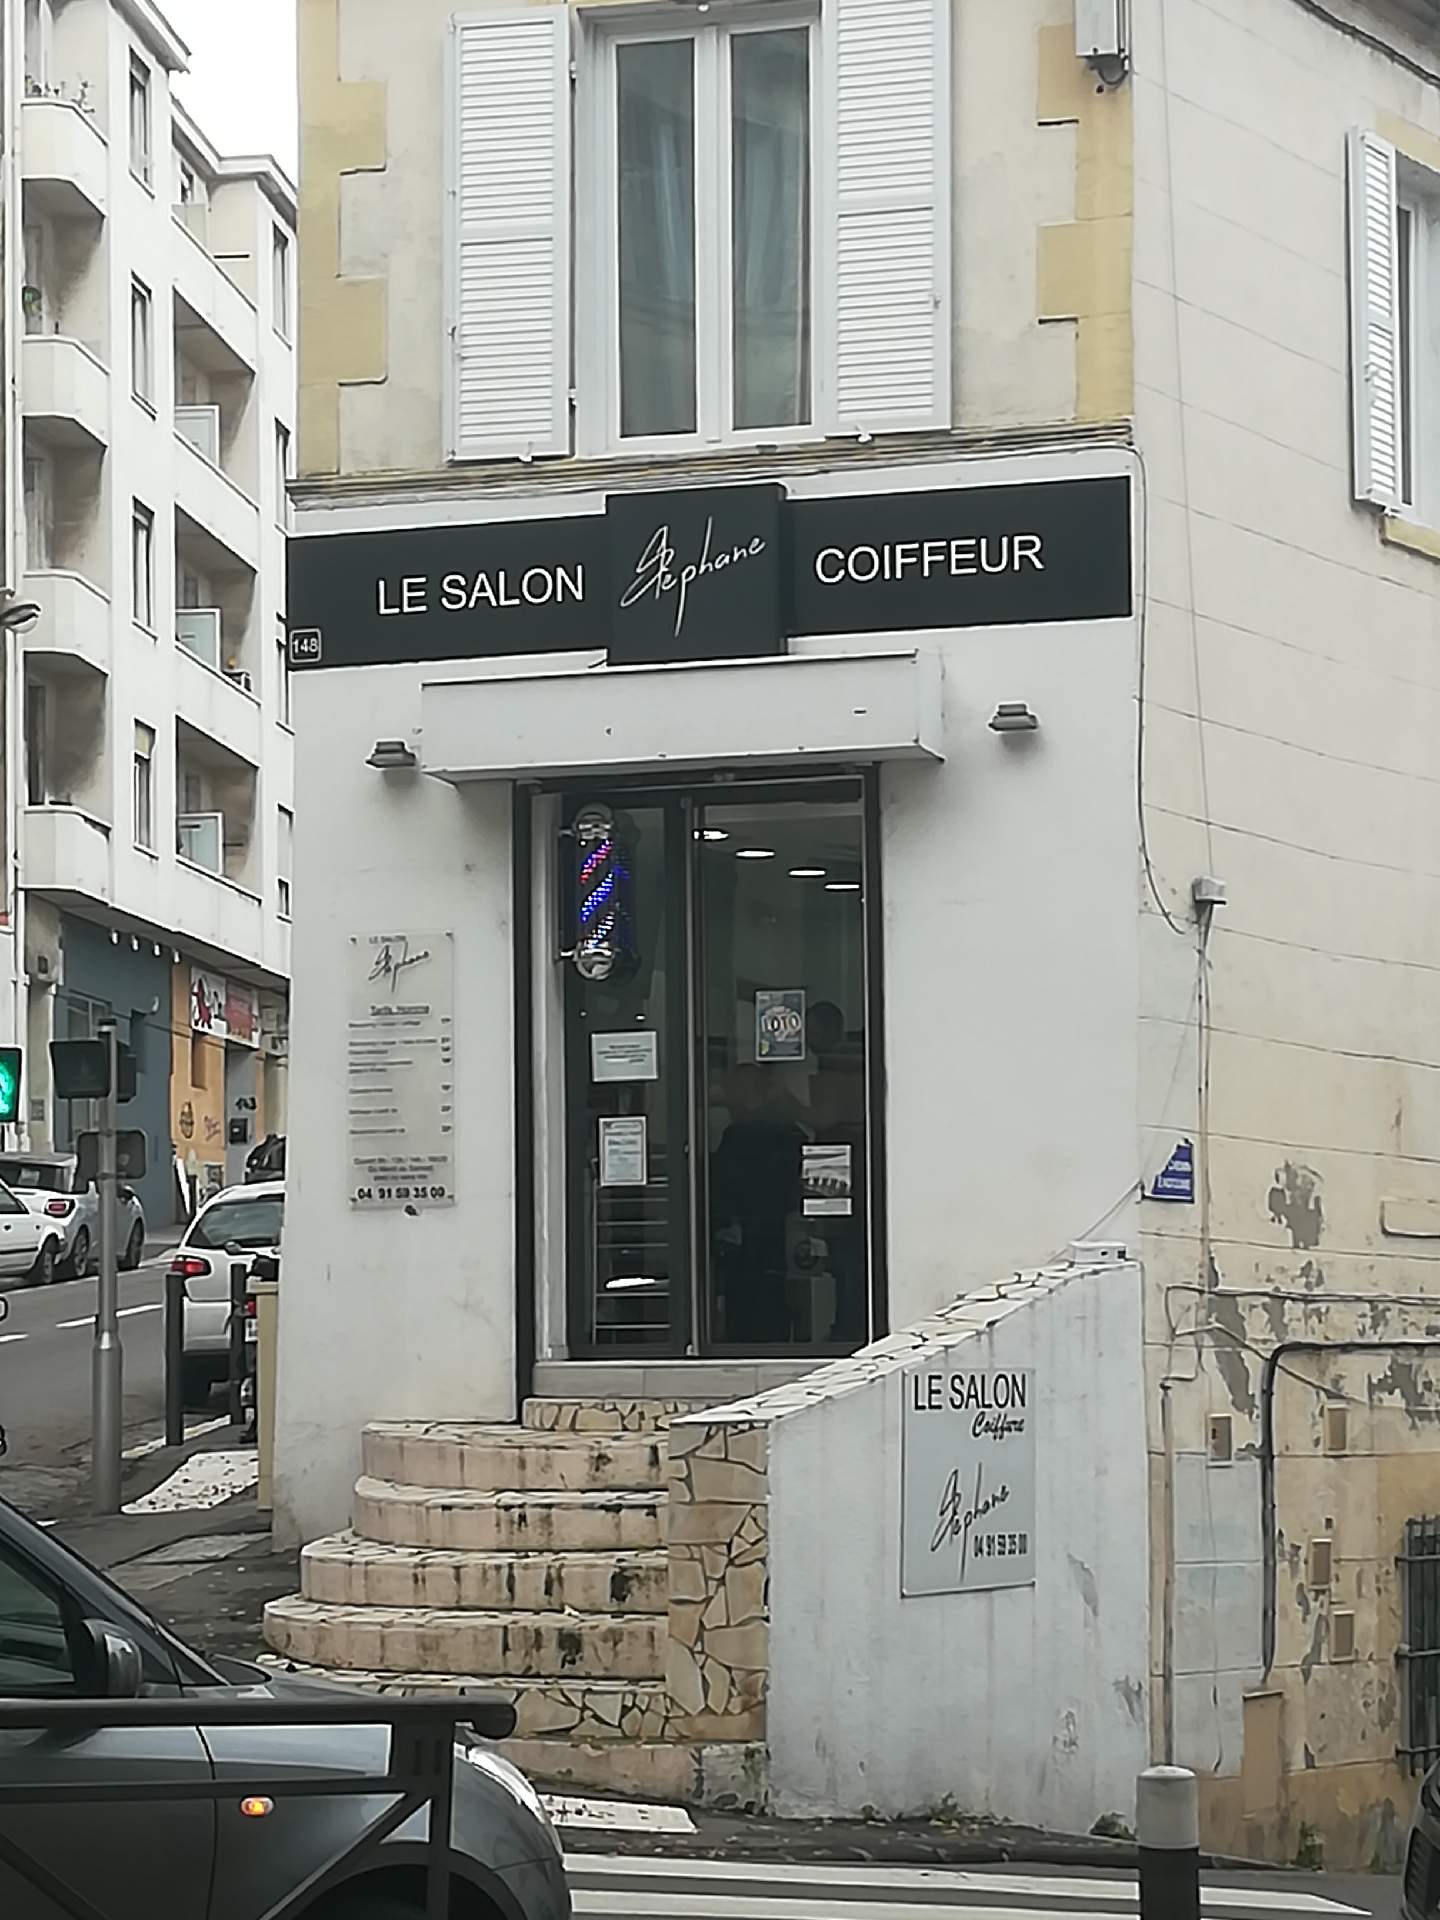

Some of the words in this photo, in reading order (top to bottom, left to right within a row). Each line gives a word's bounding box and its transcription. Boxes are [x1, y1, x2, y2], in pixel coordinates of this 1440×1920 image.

[815, 534, 1045, 584] COIFFEUR
[377, 577, 428, 615] LE
[440, 564, 584, 610] SALON
[292, 637, 319, 654] 148
[357, 1187, 372, 1199] 04
[378, 1187, 392, 1199] 91
[430, 1186, 446, 1199] 00
[913, 1374, 943, 1411] LE
[949, 1373, 1026, 1410] SALON
[971, 1411, 1025, 1440] Coiffure
